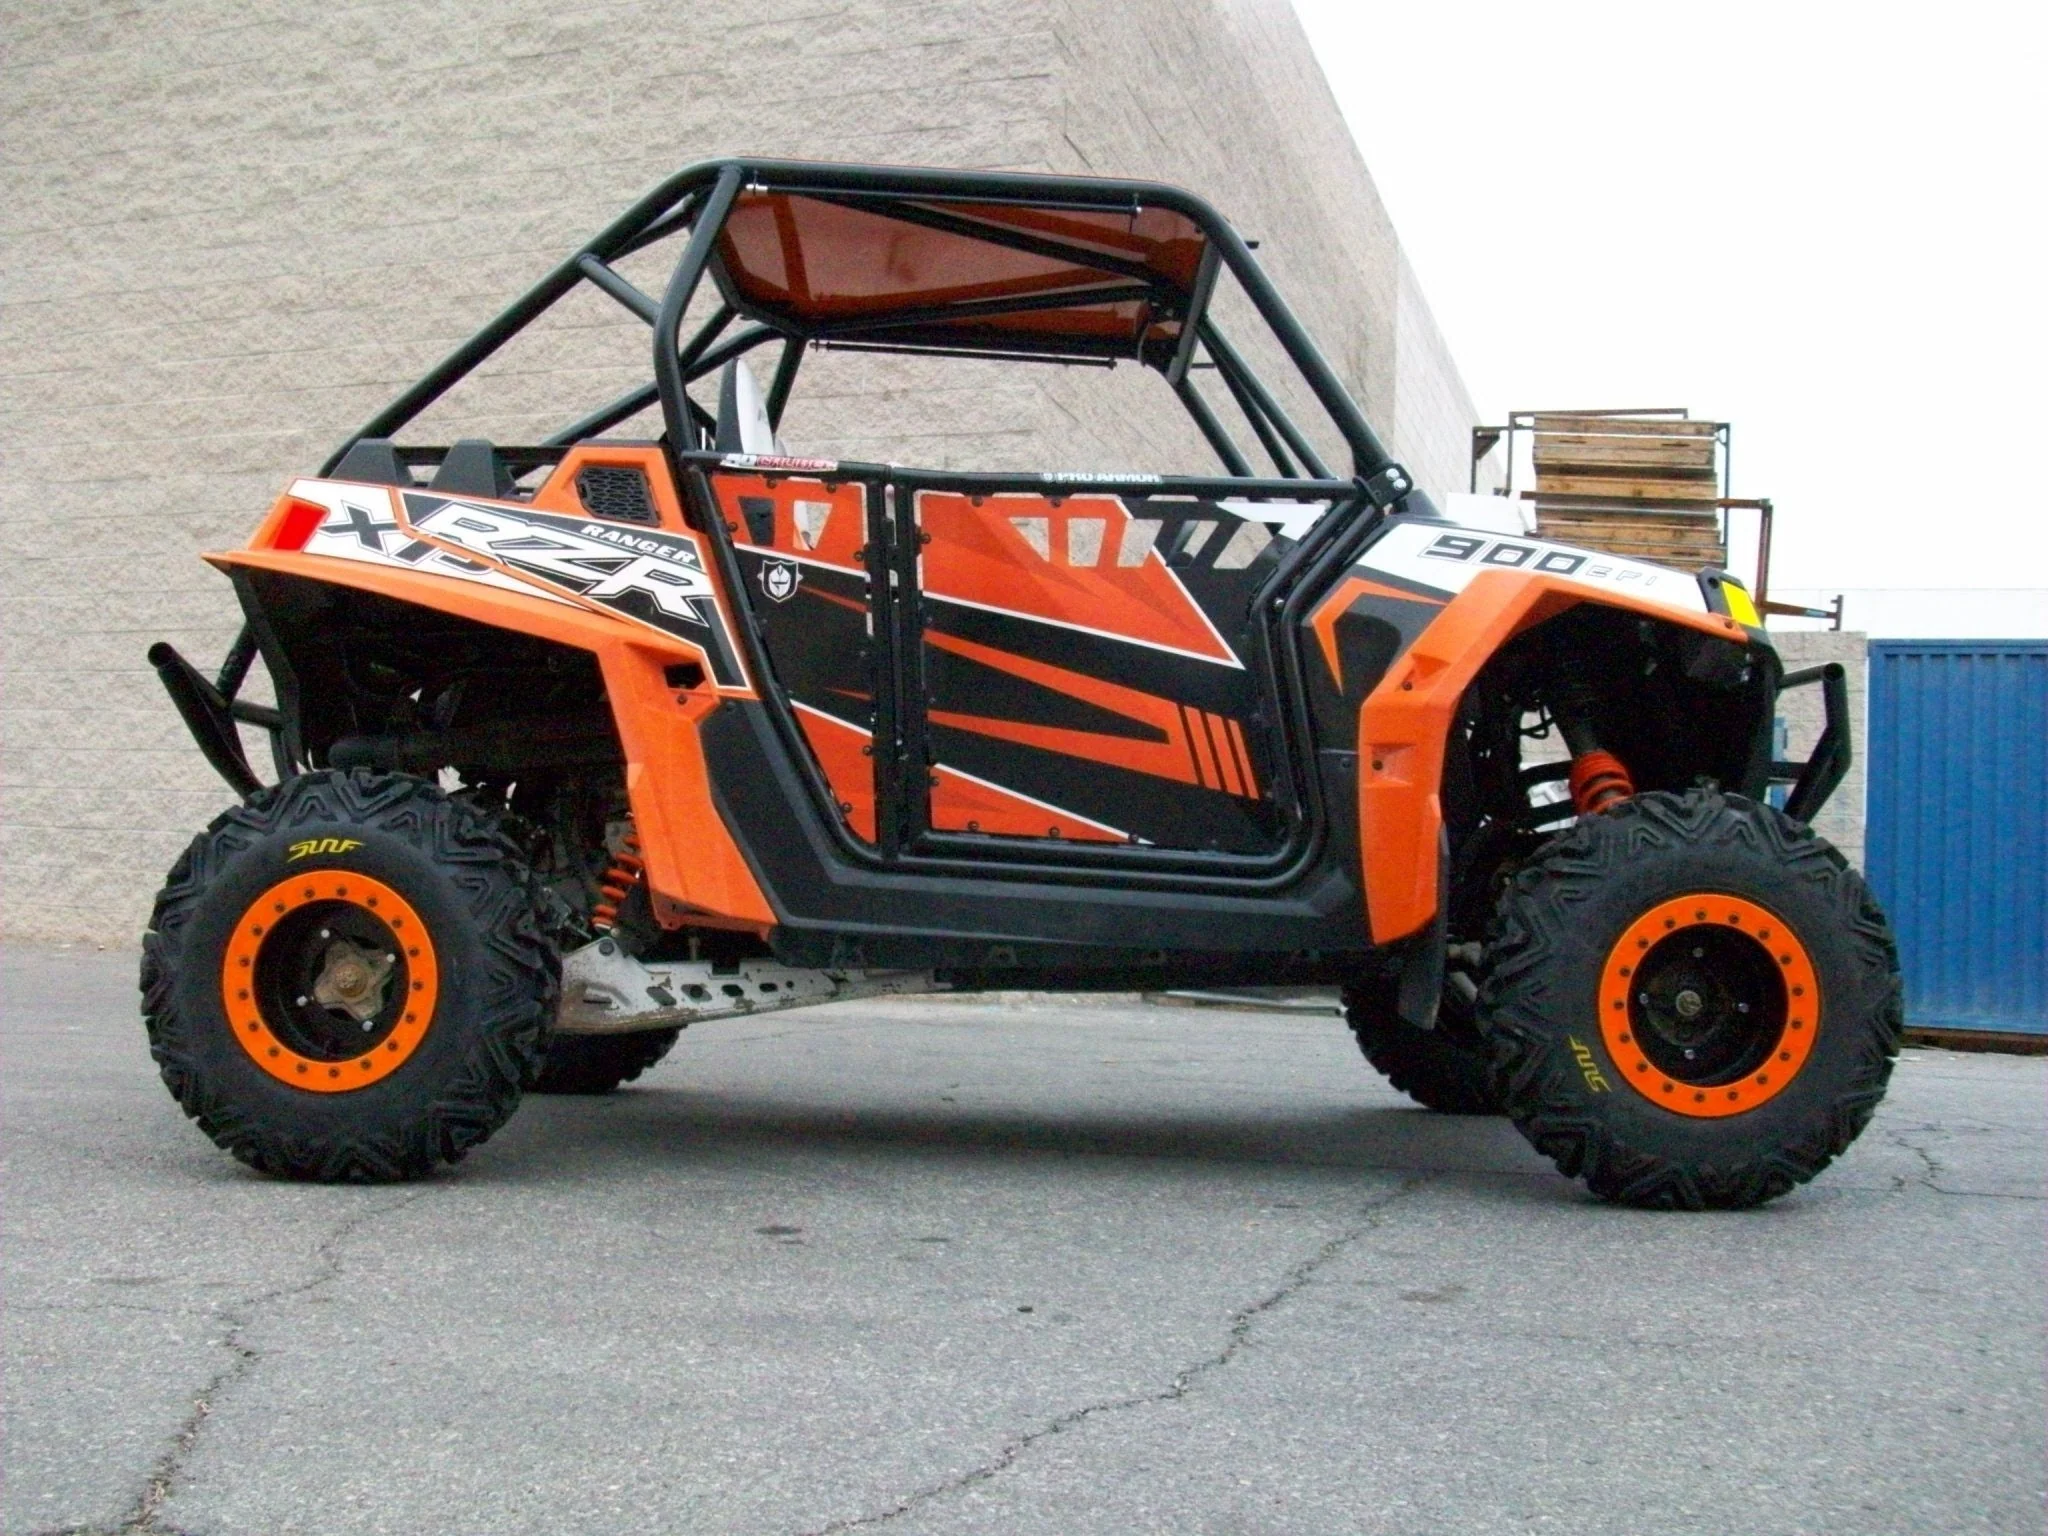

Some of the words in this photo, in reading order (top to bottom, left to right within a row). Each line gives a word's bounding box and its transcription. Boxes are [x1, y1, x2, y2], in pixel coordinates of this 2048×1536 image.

[1057, 473, 1094, 482] PRO
[1096, 473, 1161, 483] ARMOR
[411, 500, 716, 626] RZR
[581, 524, 697, 563] RANGER
[1420, 533, 1591, 577] 900
[1585, 564, 1658, 586] EFI
[287, 838, 366, 863] SUNF
[1568, 1033, 1613, 1092] SUNF
